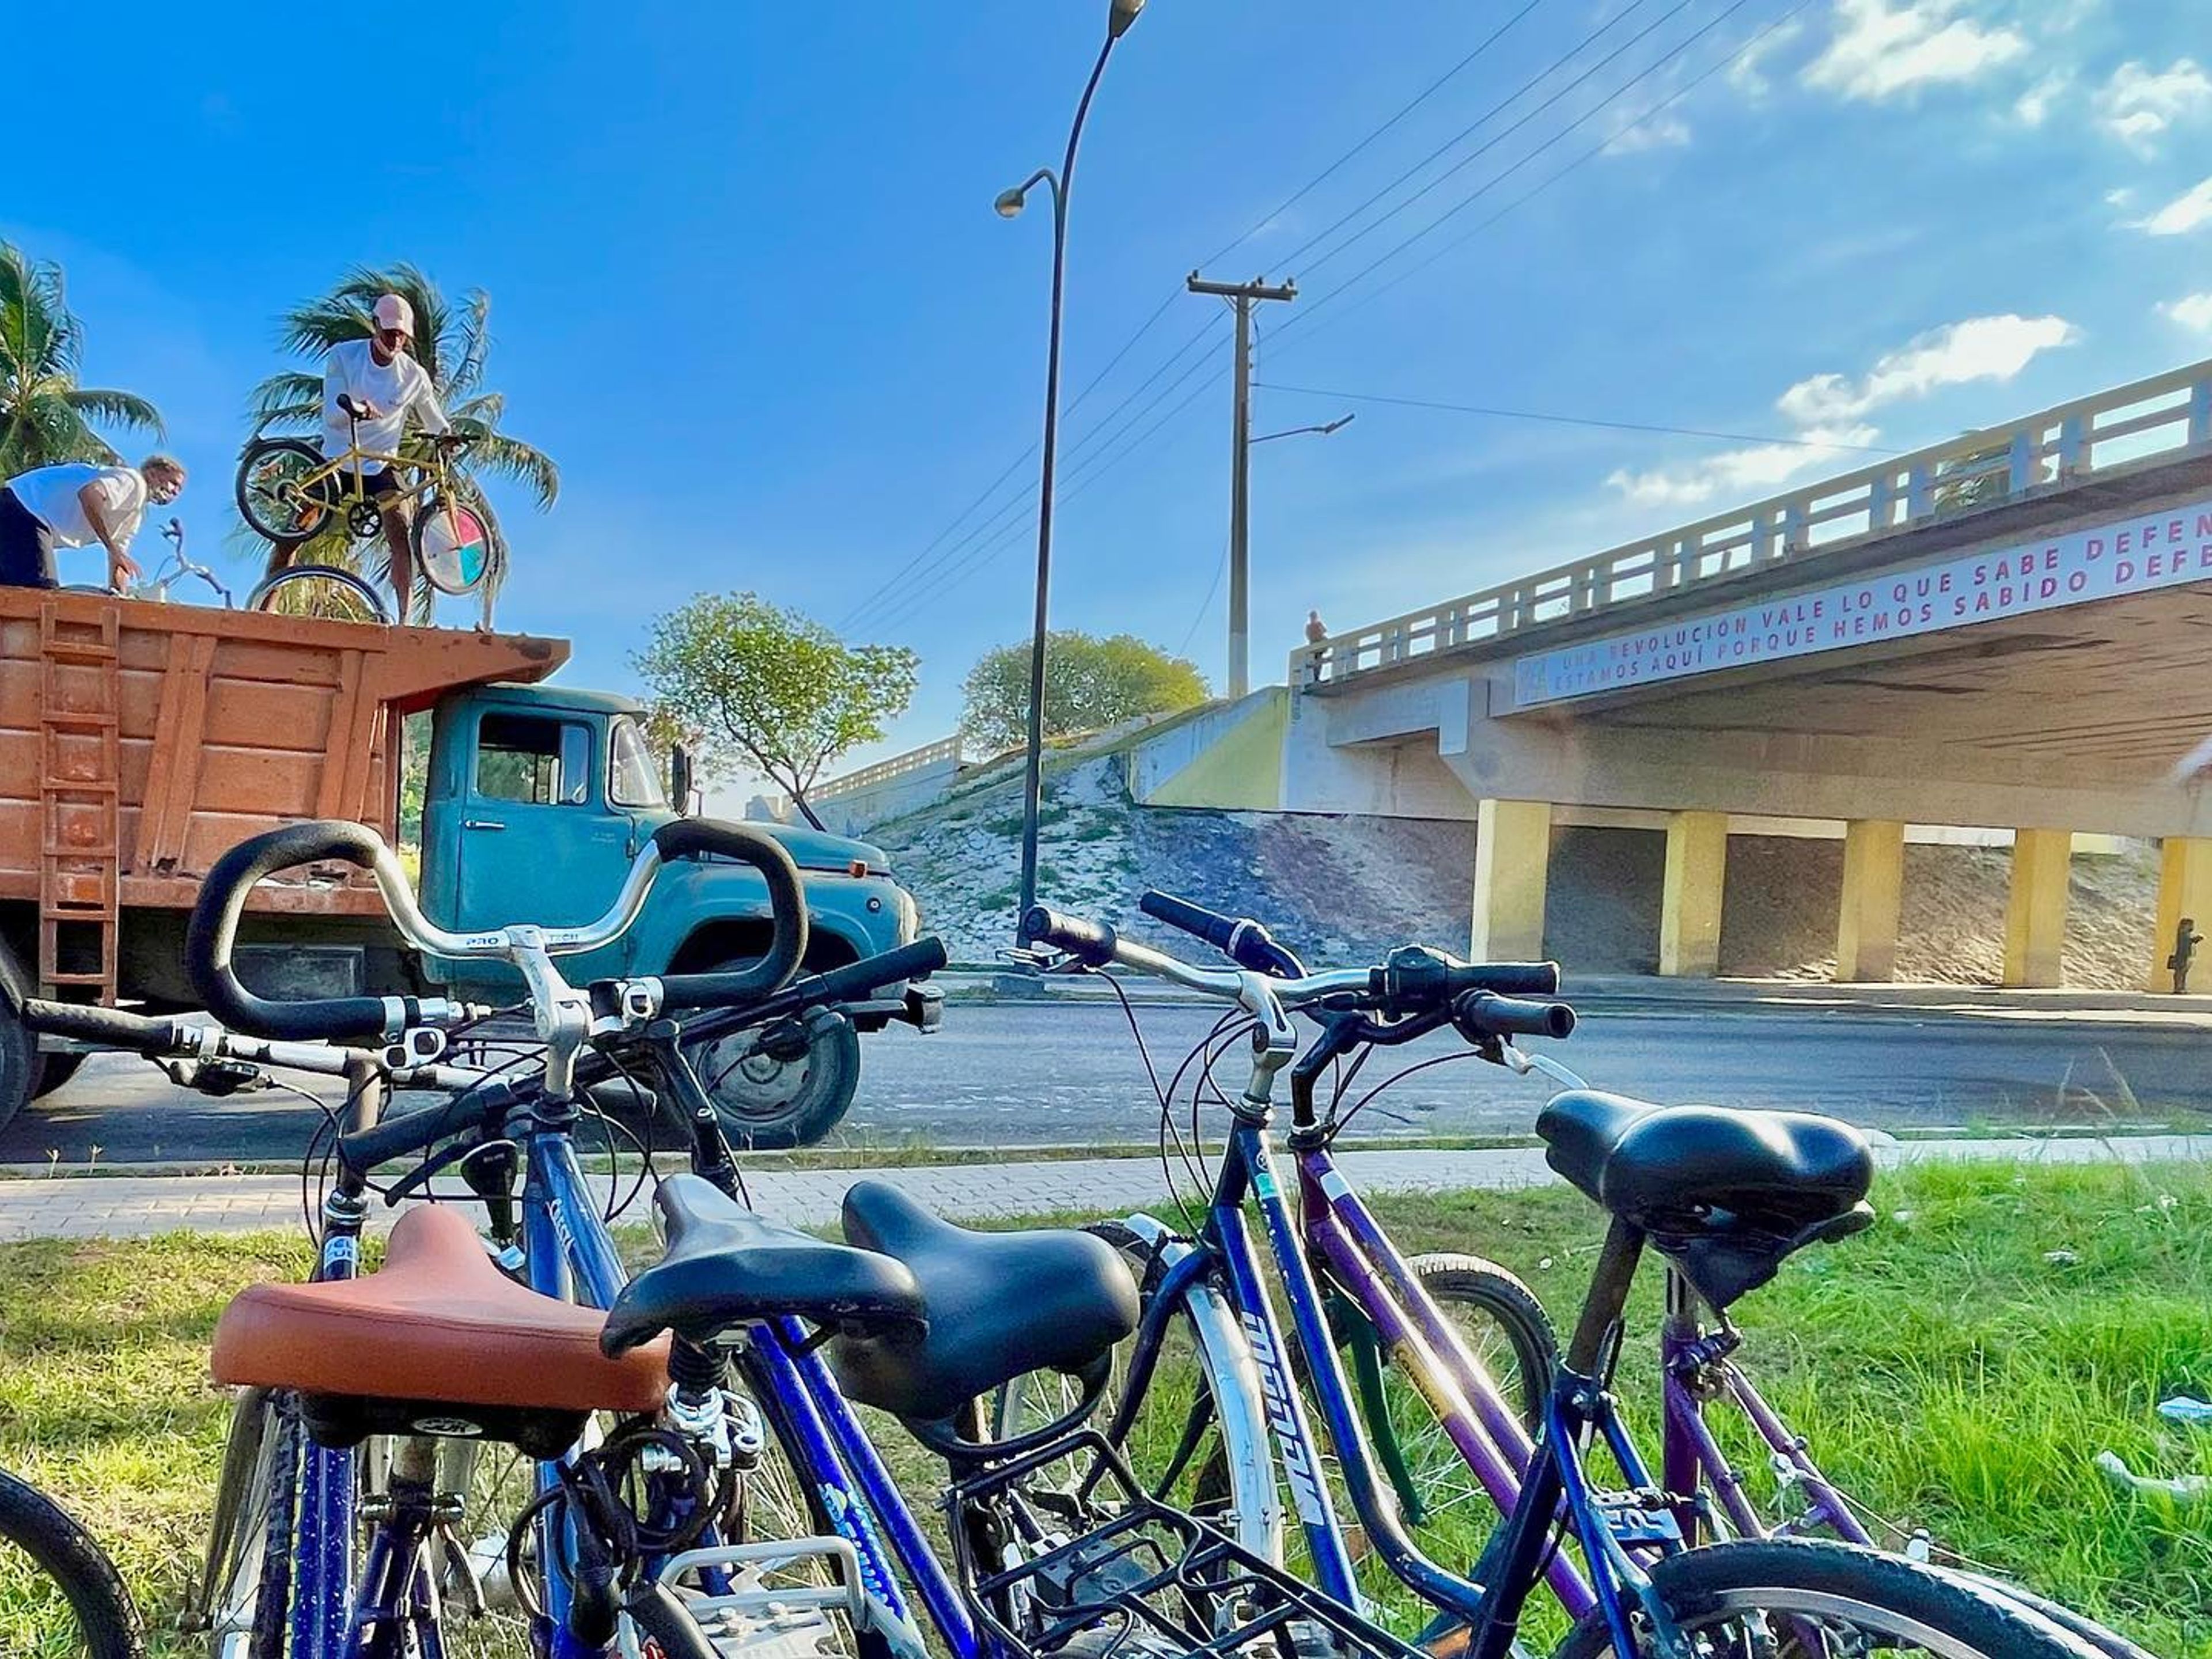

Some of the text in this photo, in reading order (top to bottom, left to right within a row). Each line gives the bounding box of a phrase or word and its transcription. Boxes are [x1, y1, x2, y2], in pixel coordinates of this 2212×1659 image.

[1556, 661, 1638, 690] ESTAMOS
[1717, 626, 1815, 659] PORQUE
[1834, 604, 1932, 638] HEMOS
[1955, 570, 2088, 616] SABIDO
[1763, 601, 1823, 628] VALE
[1843, 591, 1872, 613] LO
[1893, 574, 1951, 603] QUE
[1974, 548, 2059, 585] SABE
